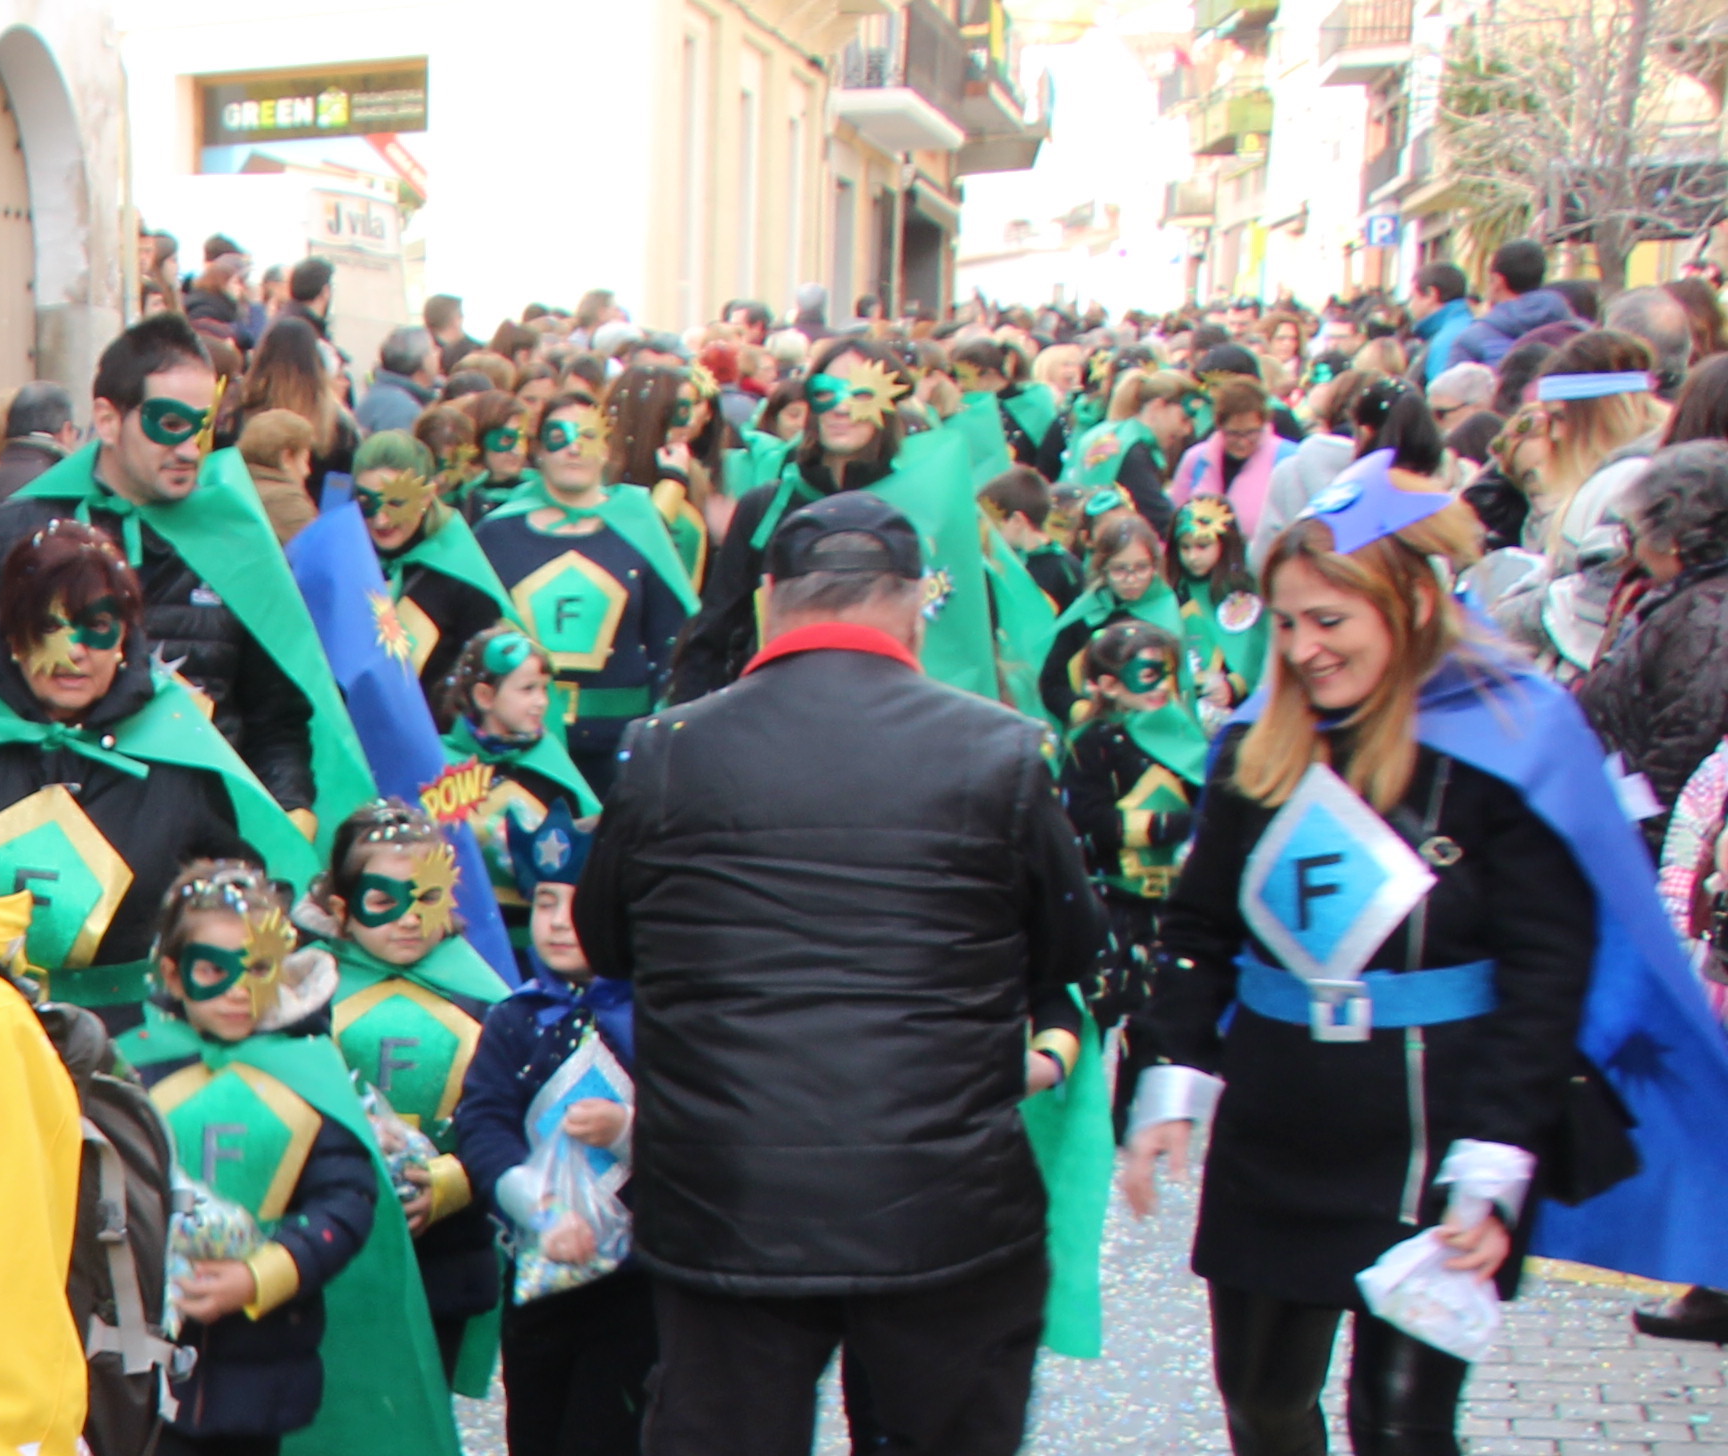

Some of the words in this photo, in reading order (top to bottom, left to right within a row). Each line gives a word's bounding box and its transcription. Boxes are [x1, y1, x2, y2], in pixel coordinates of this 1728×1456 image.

[223, 97, 315, 130] GREEN
[1372, 218, 1394, 244] P
[555, 596, 585, 634] F
[419, 764, 496, 822] POW!
[1295, 852, 1345, 931] F
[377, 1037, 420, 1091] F
[202, 1123, 247, 1184] F
